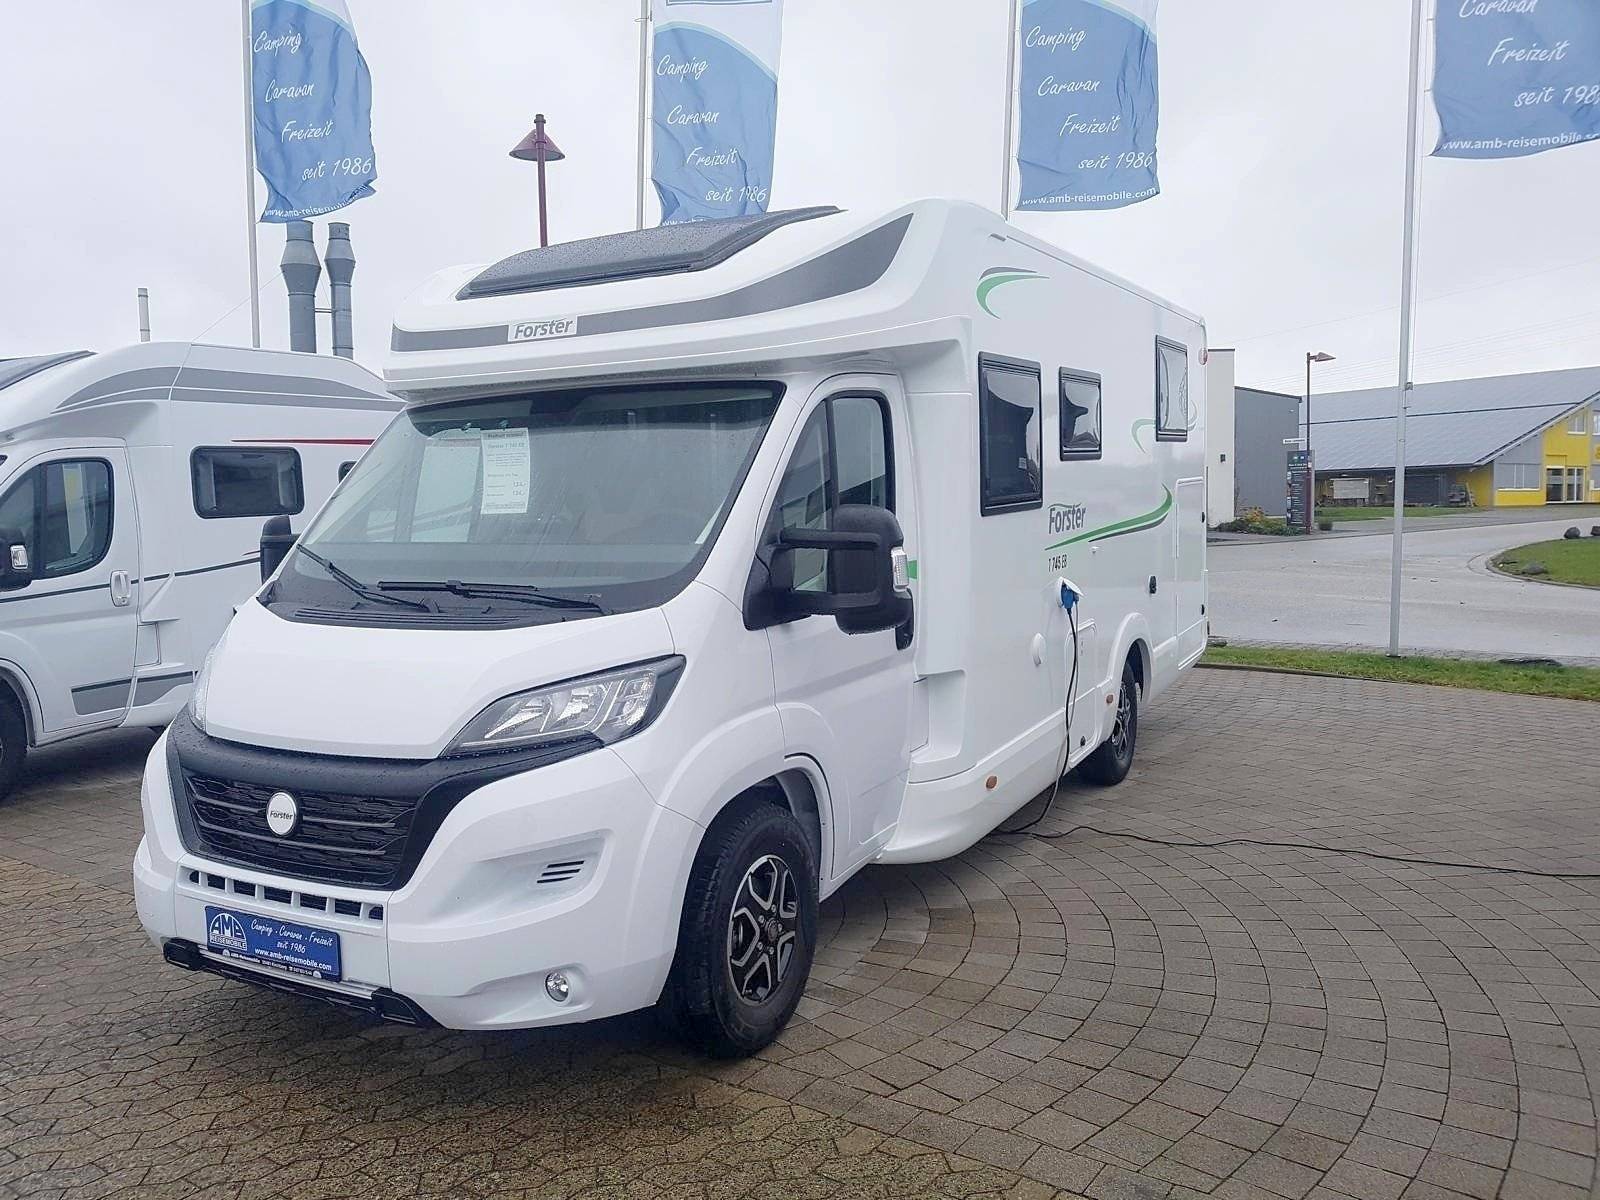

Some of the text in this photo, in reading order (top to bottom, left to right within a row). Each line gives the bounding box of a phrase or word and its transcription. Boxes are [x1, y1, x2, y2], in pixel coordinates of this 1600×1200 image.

[1459, 0, 1538, 18] Caravan
[254, 30, 302, 56] Camping
[1025, 25, 1087, 53] Camping
[1487, 38, 1571, 66] Freizeit
[657, 54, 709, 82] Camping
[265, 79, 314, 102] Caravan
[1037, 75, 1101, 96] Caravan
[1514, 86, 1554, 107] seit
[667, 105, 720, 125] Caravan
[1060, 114, 1121, 136] Freizeit
[281, 120, 334, 142] Freizeit
[686, 147, 738, 166] Freizeit
[1078, 151, 1155, 169] seit 1986
[301, 157, 373, 182] seit 1986
[705, 186, 767, 202] seit 1986
[1022, 187, 1157, 204] www.amb-reisemobile.com
[514, 319, 574, 339] Forster
[1048, 504, 1087, 535] Forster
[270, 810, 294, 820] Forster
[251, 918, 334, 947] Camping Caravan Freizeit
[290, 942, 306, 954] 1986
[254, 947, 332, 972] www.amb-reisemobile.com
